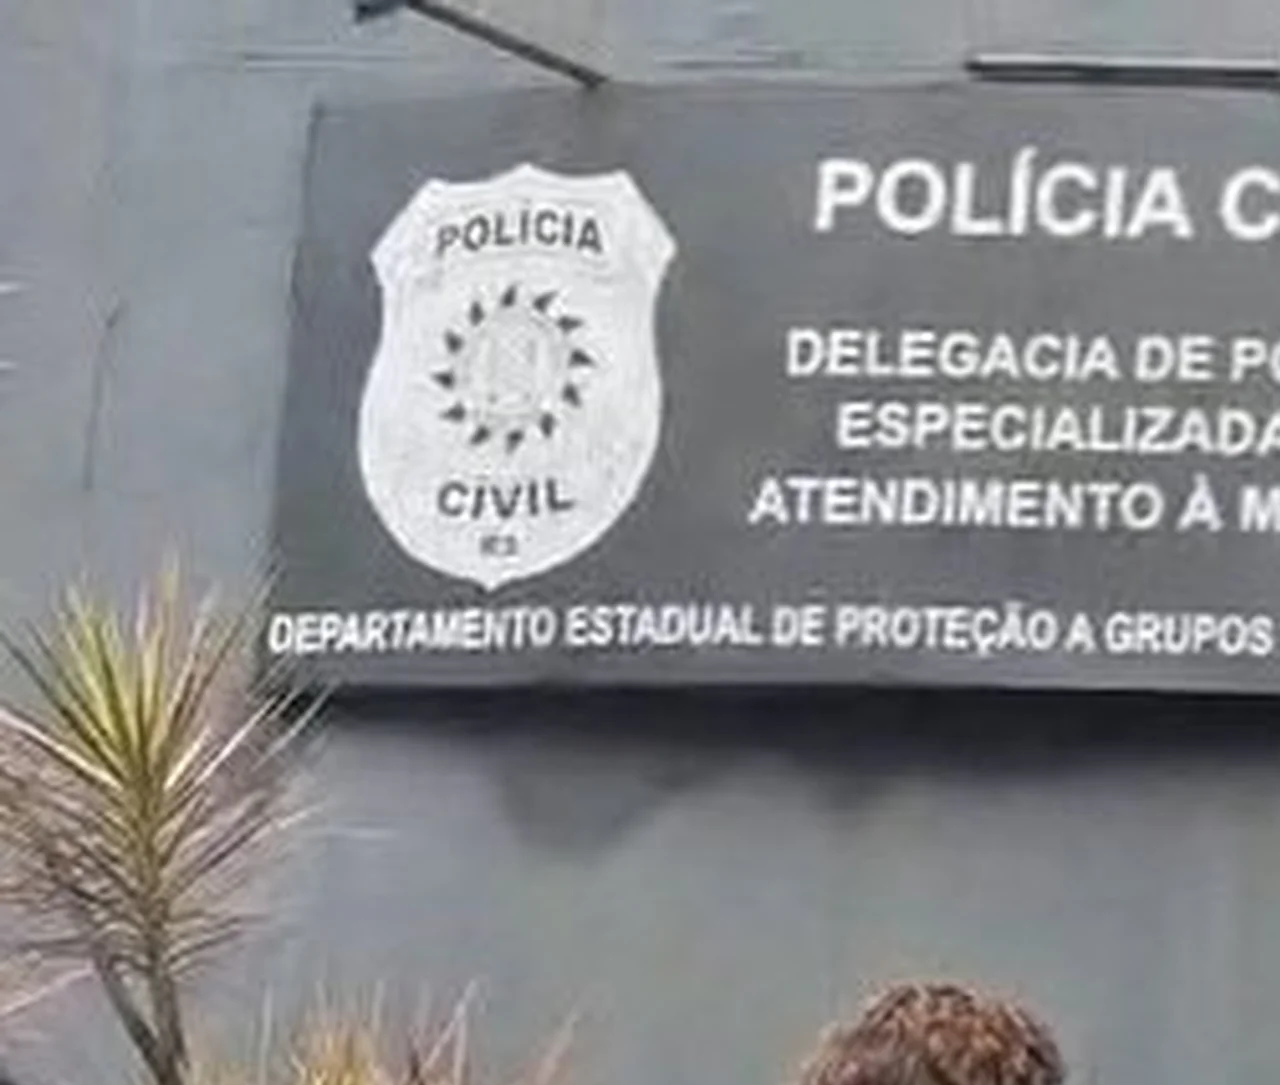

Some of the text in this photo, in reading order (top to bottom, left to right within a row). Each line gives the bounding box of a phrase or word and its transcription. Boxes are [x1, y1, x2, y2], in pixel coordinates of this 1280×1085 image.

[813, 146, 1193, 240] POLÍCIA
[786, 329, 1119, 381] DELEGACIA
[1134, 335, 1214, 384] DE
[437, 478, 575, 519] CIVIL
[747, 476, 1163, 529] ATENDIMENTO
[1176, 473, 1224, 532] À
[268, 608, 554, 653] DEPARTAMENTO
[566, 604, 762, 647] ESTADUAL
[772, 605, 826, 647] DE
[836, 602, 1058, 658] PROTEÇÃO
[1068, 612, 1094, 651] A
[1104, 612, 1274, 658] GRUPOS
